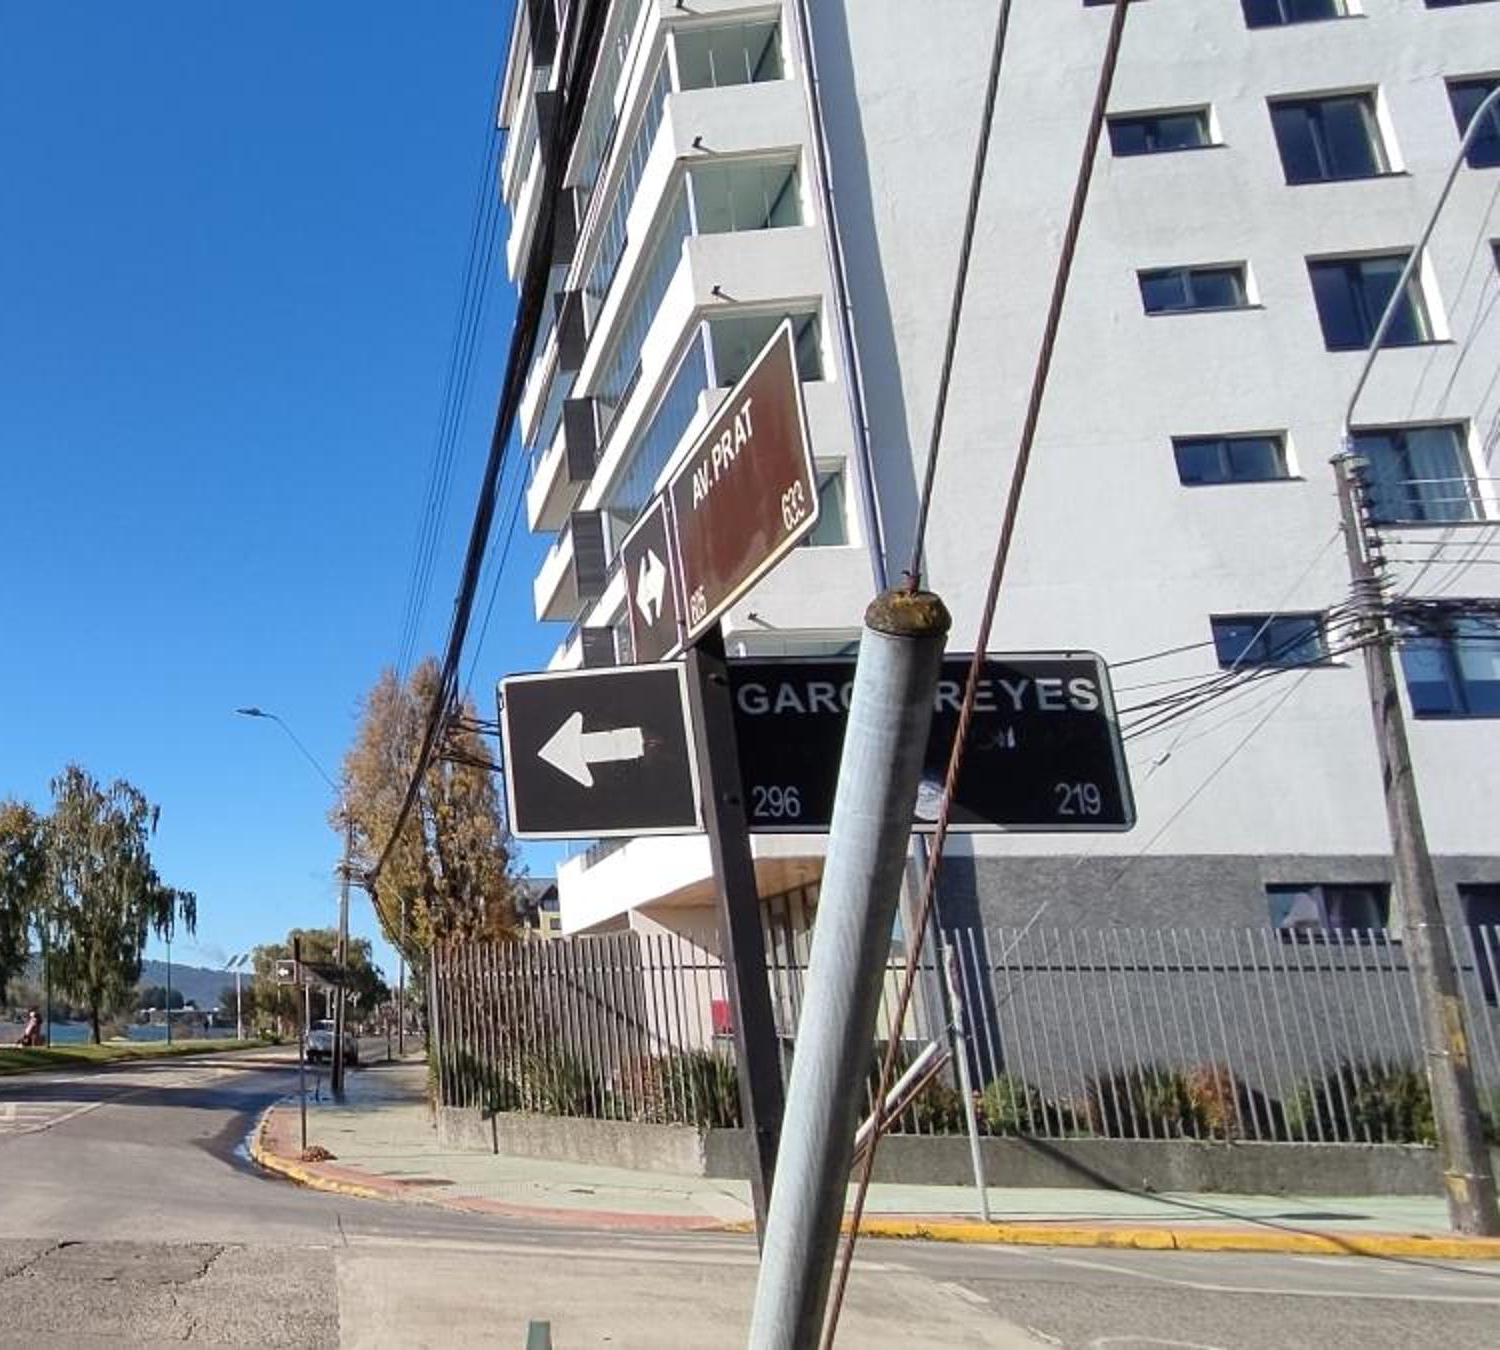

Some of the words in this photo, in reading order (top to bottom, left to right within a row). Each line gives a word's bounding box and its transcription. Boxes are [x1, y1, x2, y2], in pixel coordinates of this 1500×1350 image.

[781, 480, 804, 530] 633
[934, 678, 1099, 713] REYES
[752, 785, 801, 817] 296
[1055, 783, 1101, 815] 219
